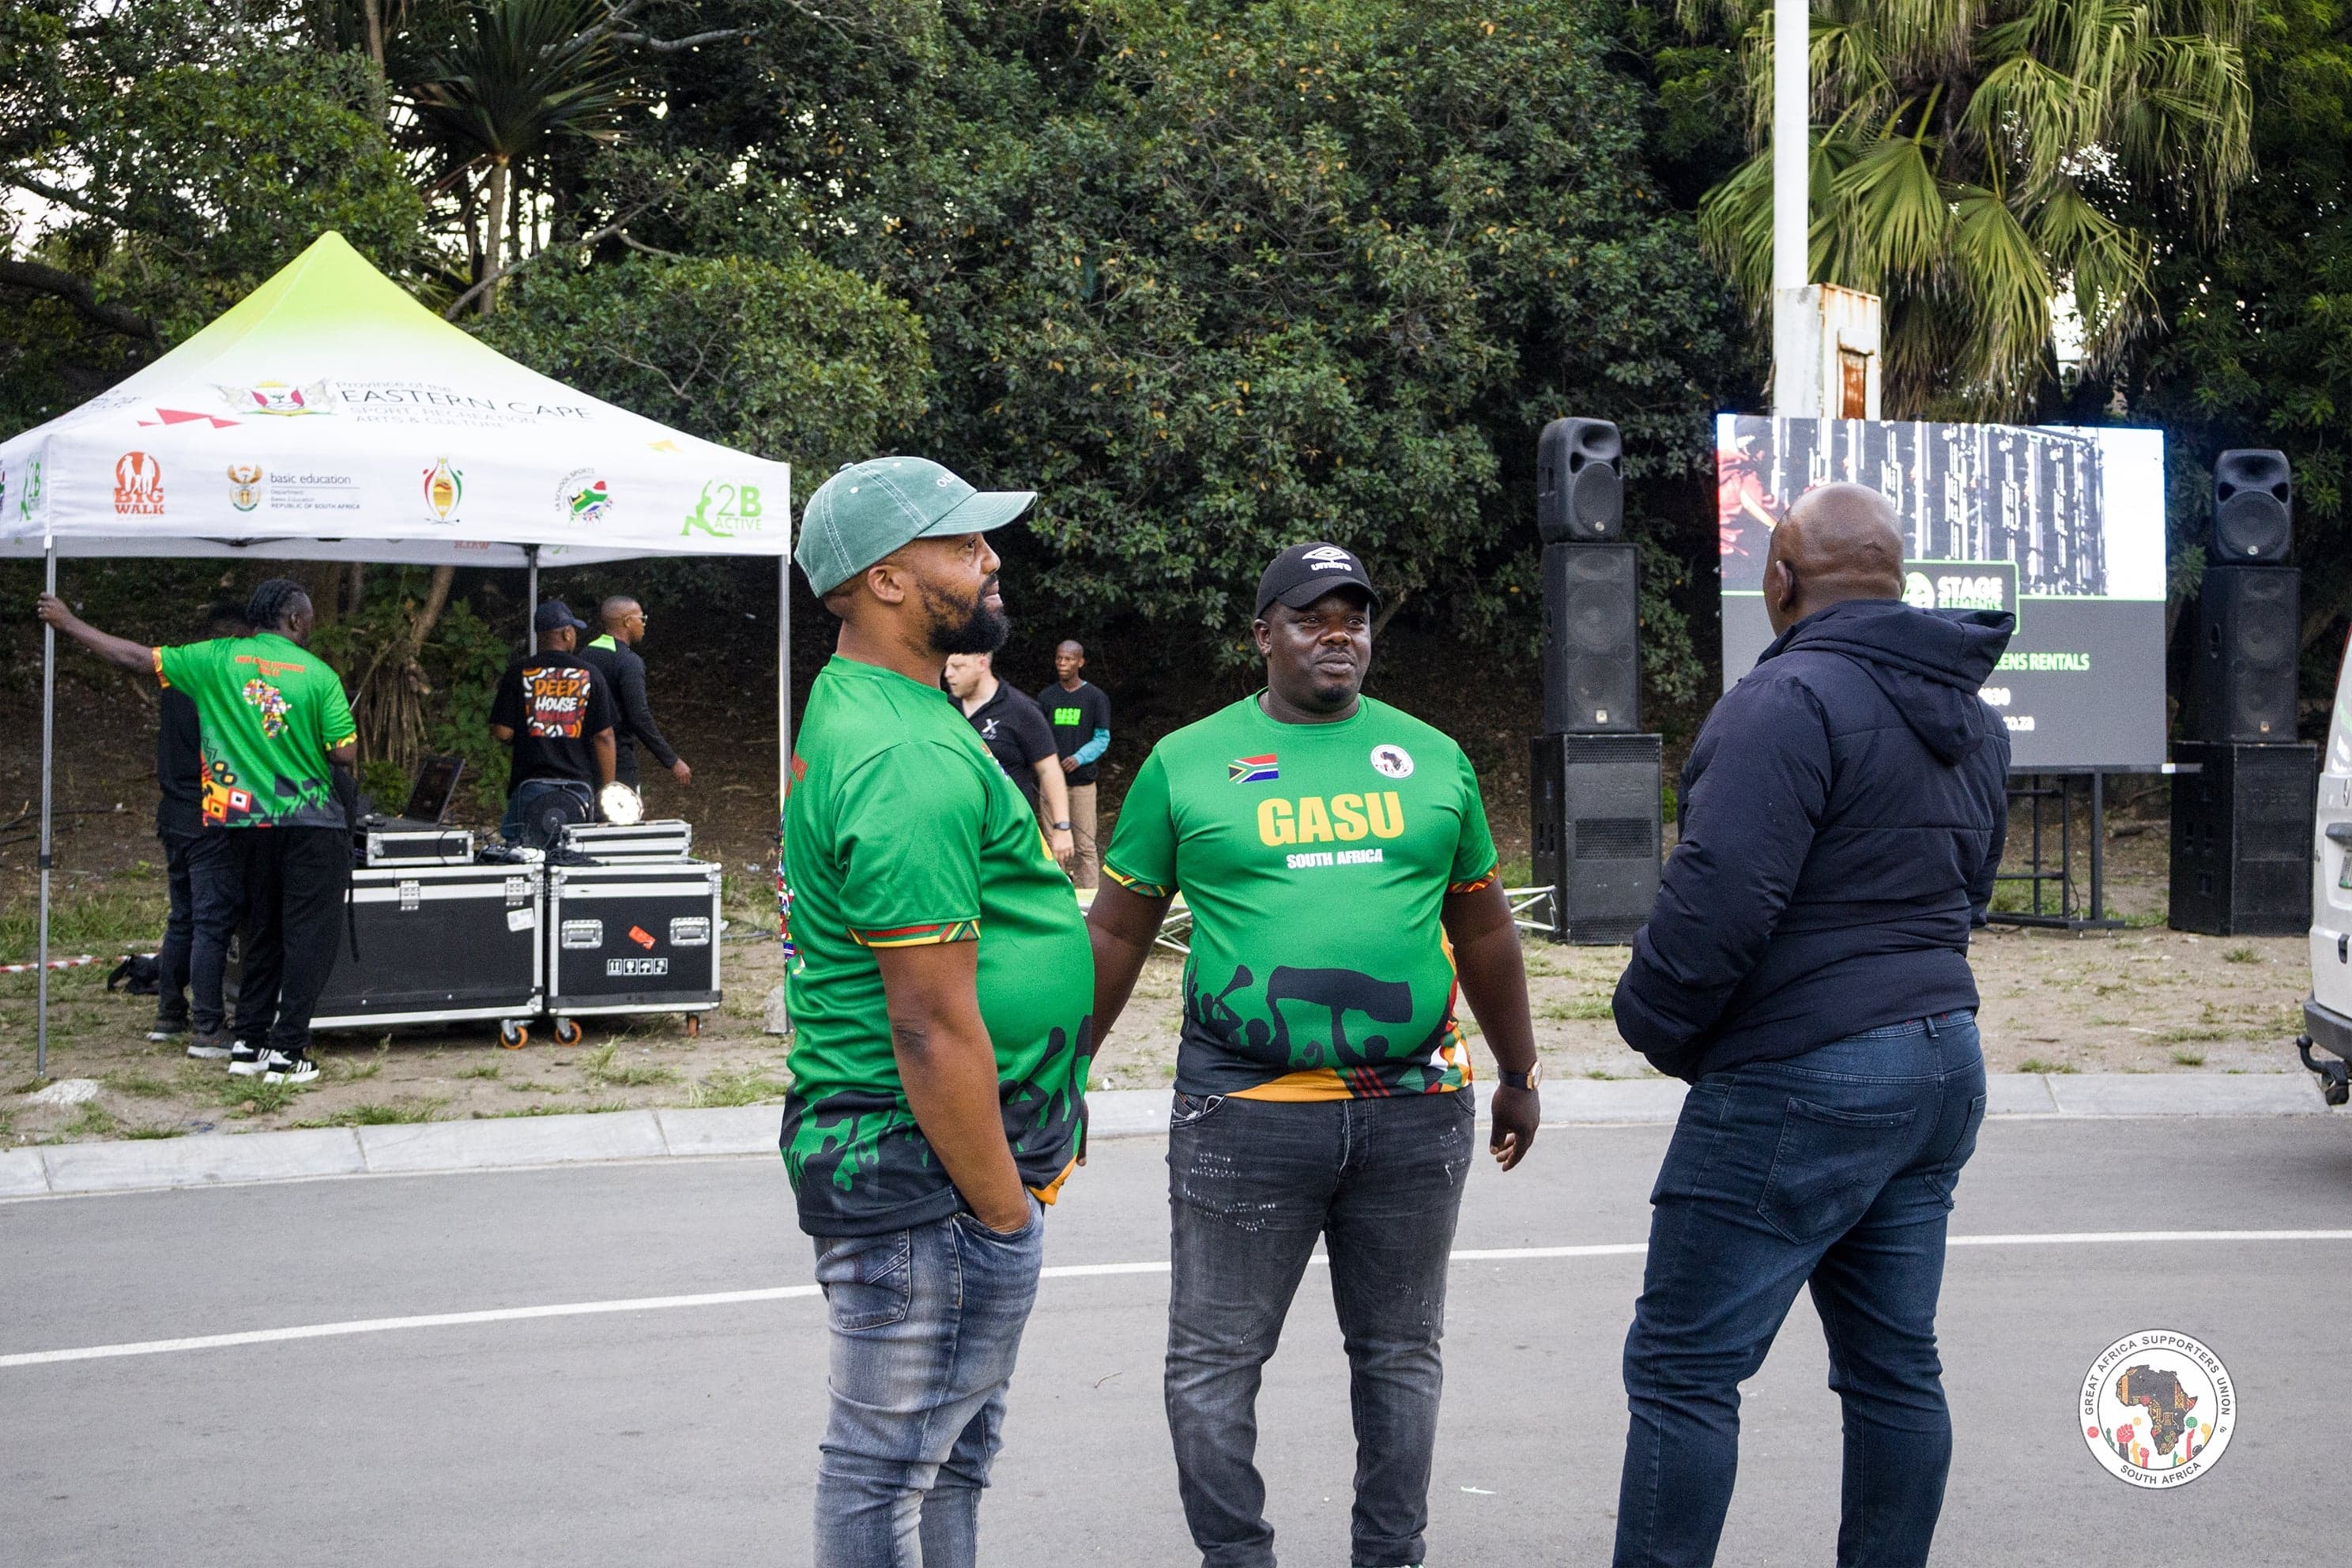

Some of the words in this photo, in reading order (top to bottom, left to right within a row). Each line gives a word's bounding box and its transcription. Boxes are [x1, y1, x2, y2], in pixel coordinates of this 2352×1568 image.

[341, 390, 496, 410] EASTERN
[508, 401, 594, 419] CAPE
[270, 472, 296, 484] basic
[300, 473, 351, 484] education
[114, 487, 165, 503] BIG
[716, 483, 763, 517] 2B
[115, 504, 165, 515] WALK
[714, 517, 763, 531] ACTIVE
[1310, 560, 1352, 571] umbro
[1937, 576, 2003, 600] STAGE
[2029, 653, 2090, 670] RENTALS
[534, 679, 580, 696] DEEP
[535, 695, 578, 712] HOUSE
[1257, 791, 1404, 846] GASU
[1286, 852, 1333, 869] SOUTH
[1336, 848, 1384, 865] AFRICA
